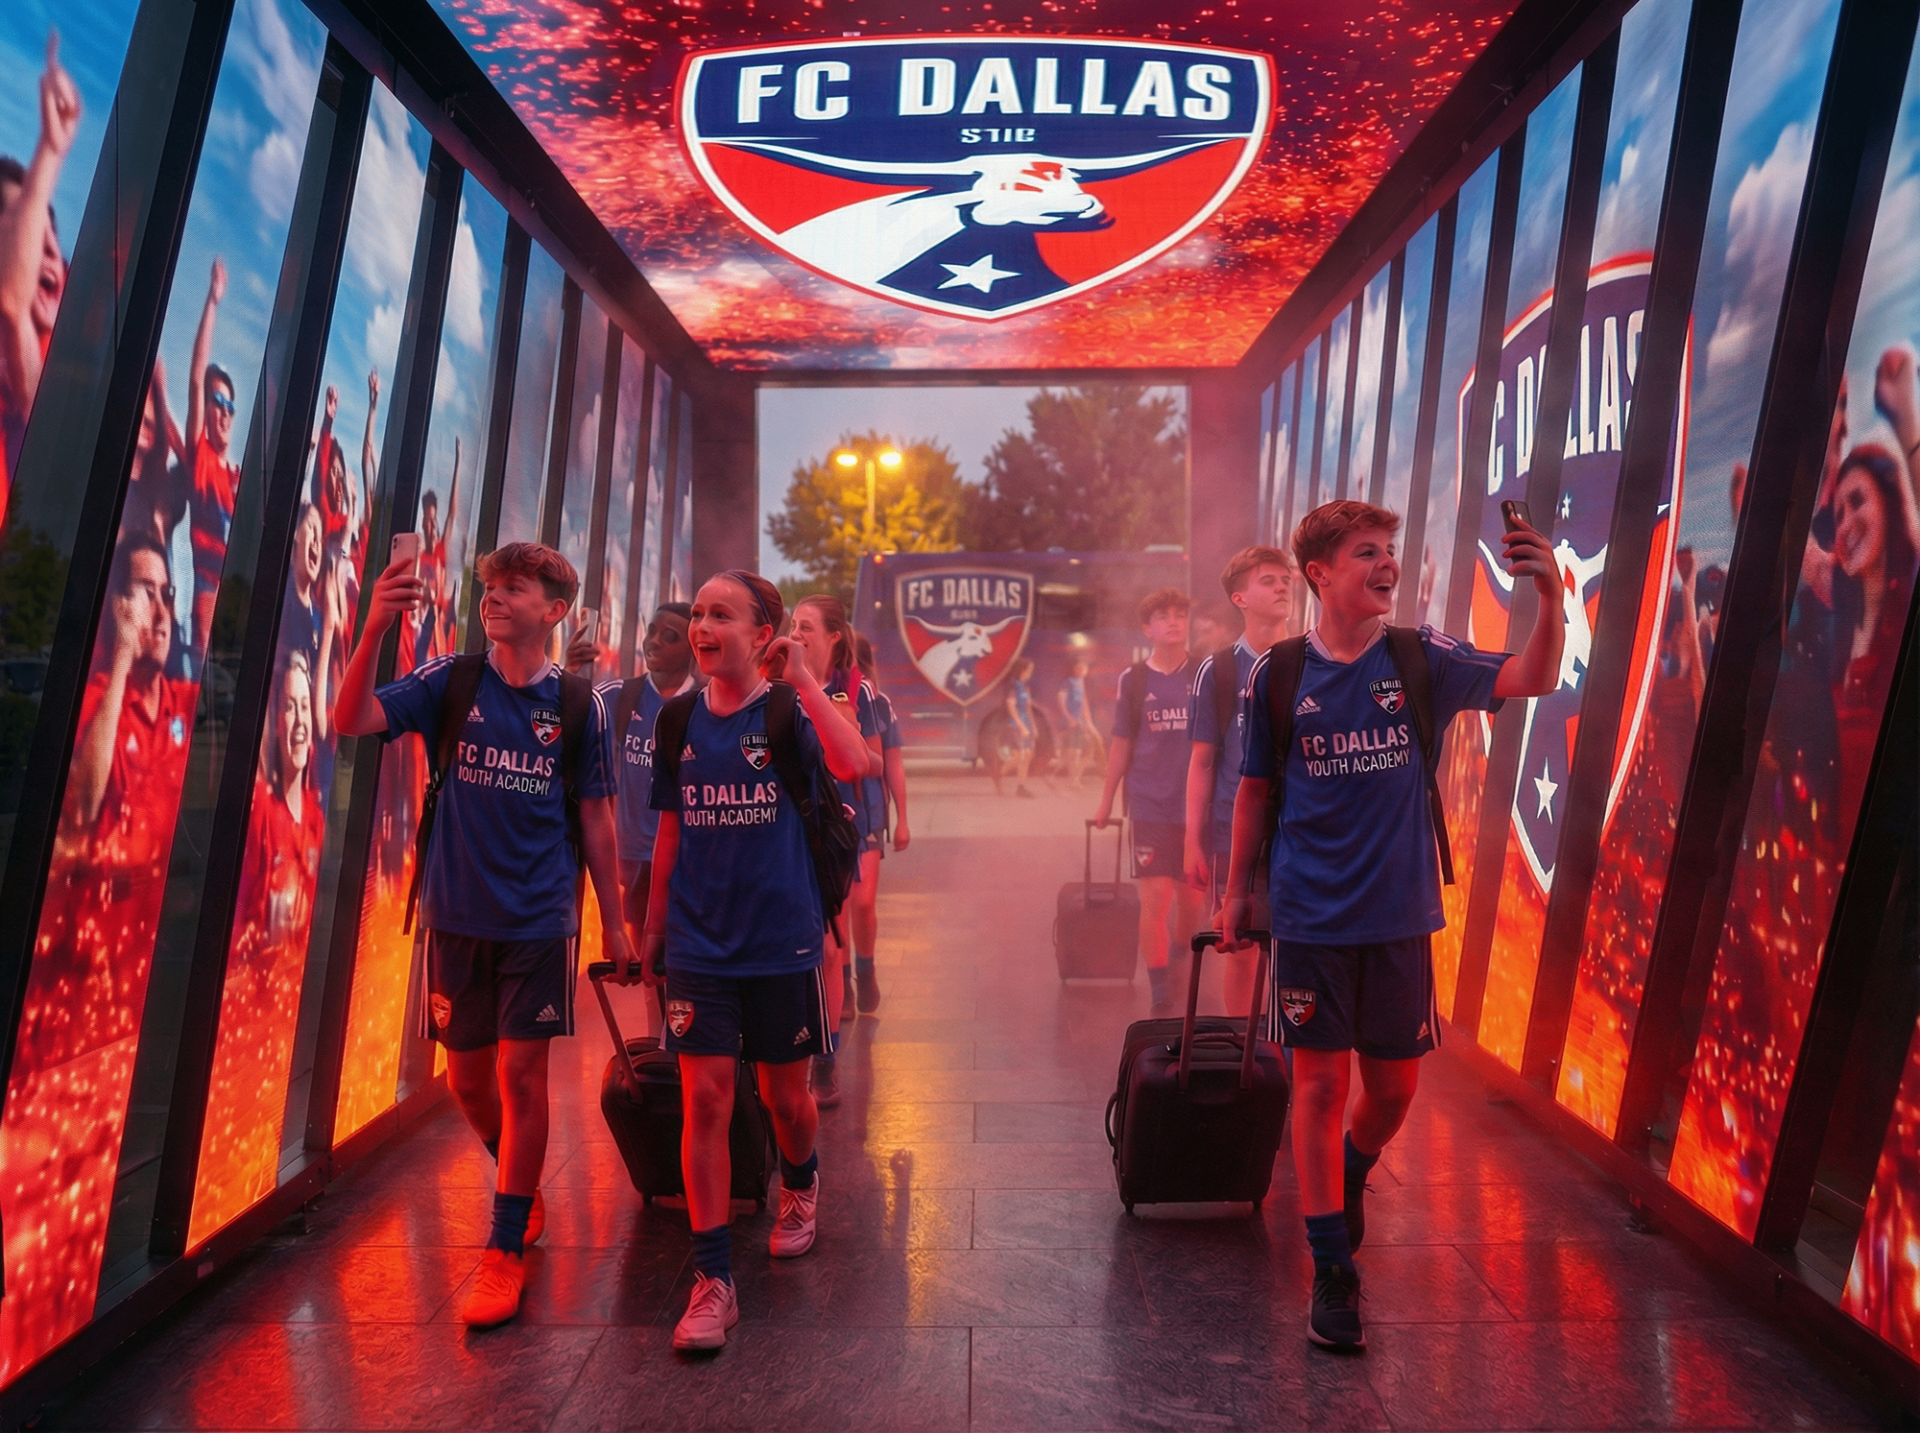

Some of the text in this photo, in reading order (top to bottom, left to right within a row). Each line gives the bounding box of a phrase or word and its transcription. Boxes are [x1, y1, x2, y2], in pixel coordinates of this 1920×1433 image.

[737, 57, 1231, 124] FC DALLAS
[1487, 379, 1504, 496] C
[907, 577, 1022, 610] FC DALLAS
[1162, 707, 1188, 720] DALL
[625, 734, 641, 750] FC
[1301, 724, 1409, 757] FC DALLAS
[458, 741, 555, 778] FC DALLAS
[626, 751, 652, 767] OUTH
[1306, 748, 1410, 777] YOUTH ACADEMY
[495, 773, 550, 796] ACADEMY
[703, 781, 777, 806] DALLAS
[719, 807, 777, 825] ACADEMY
